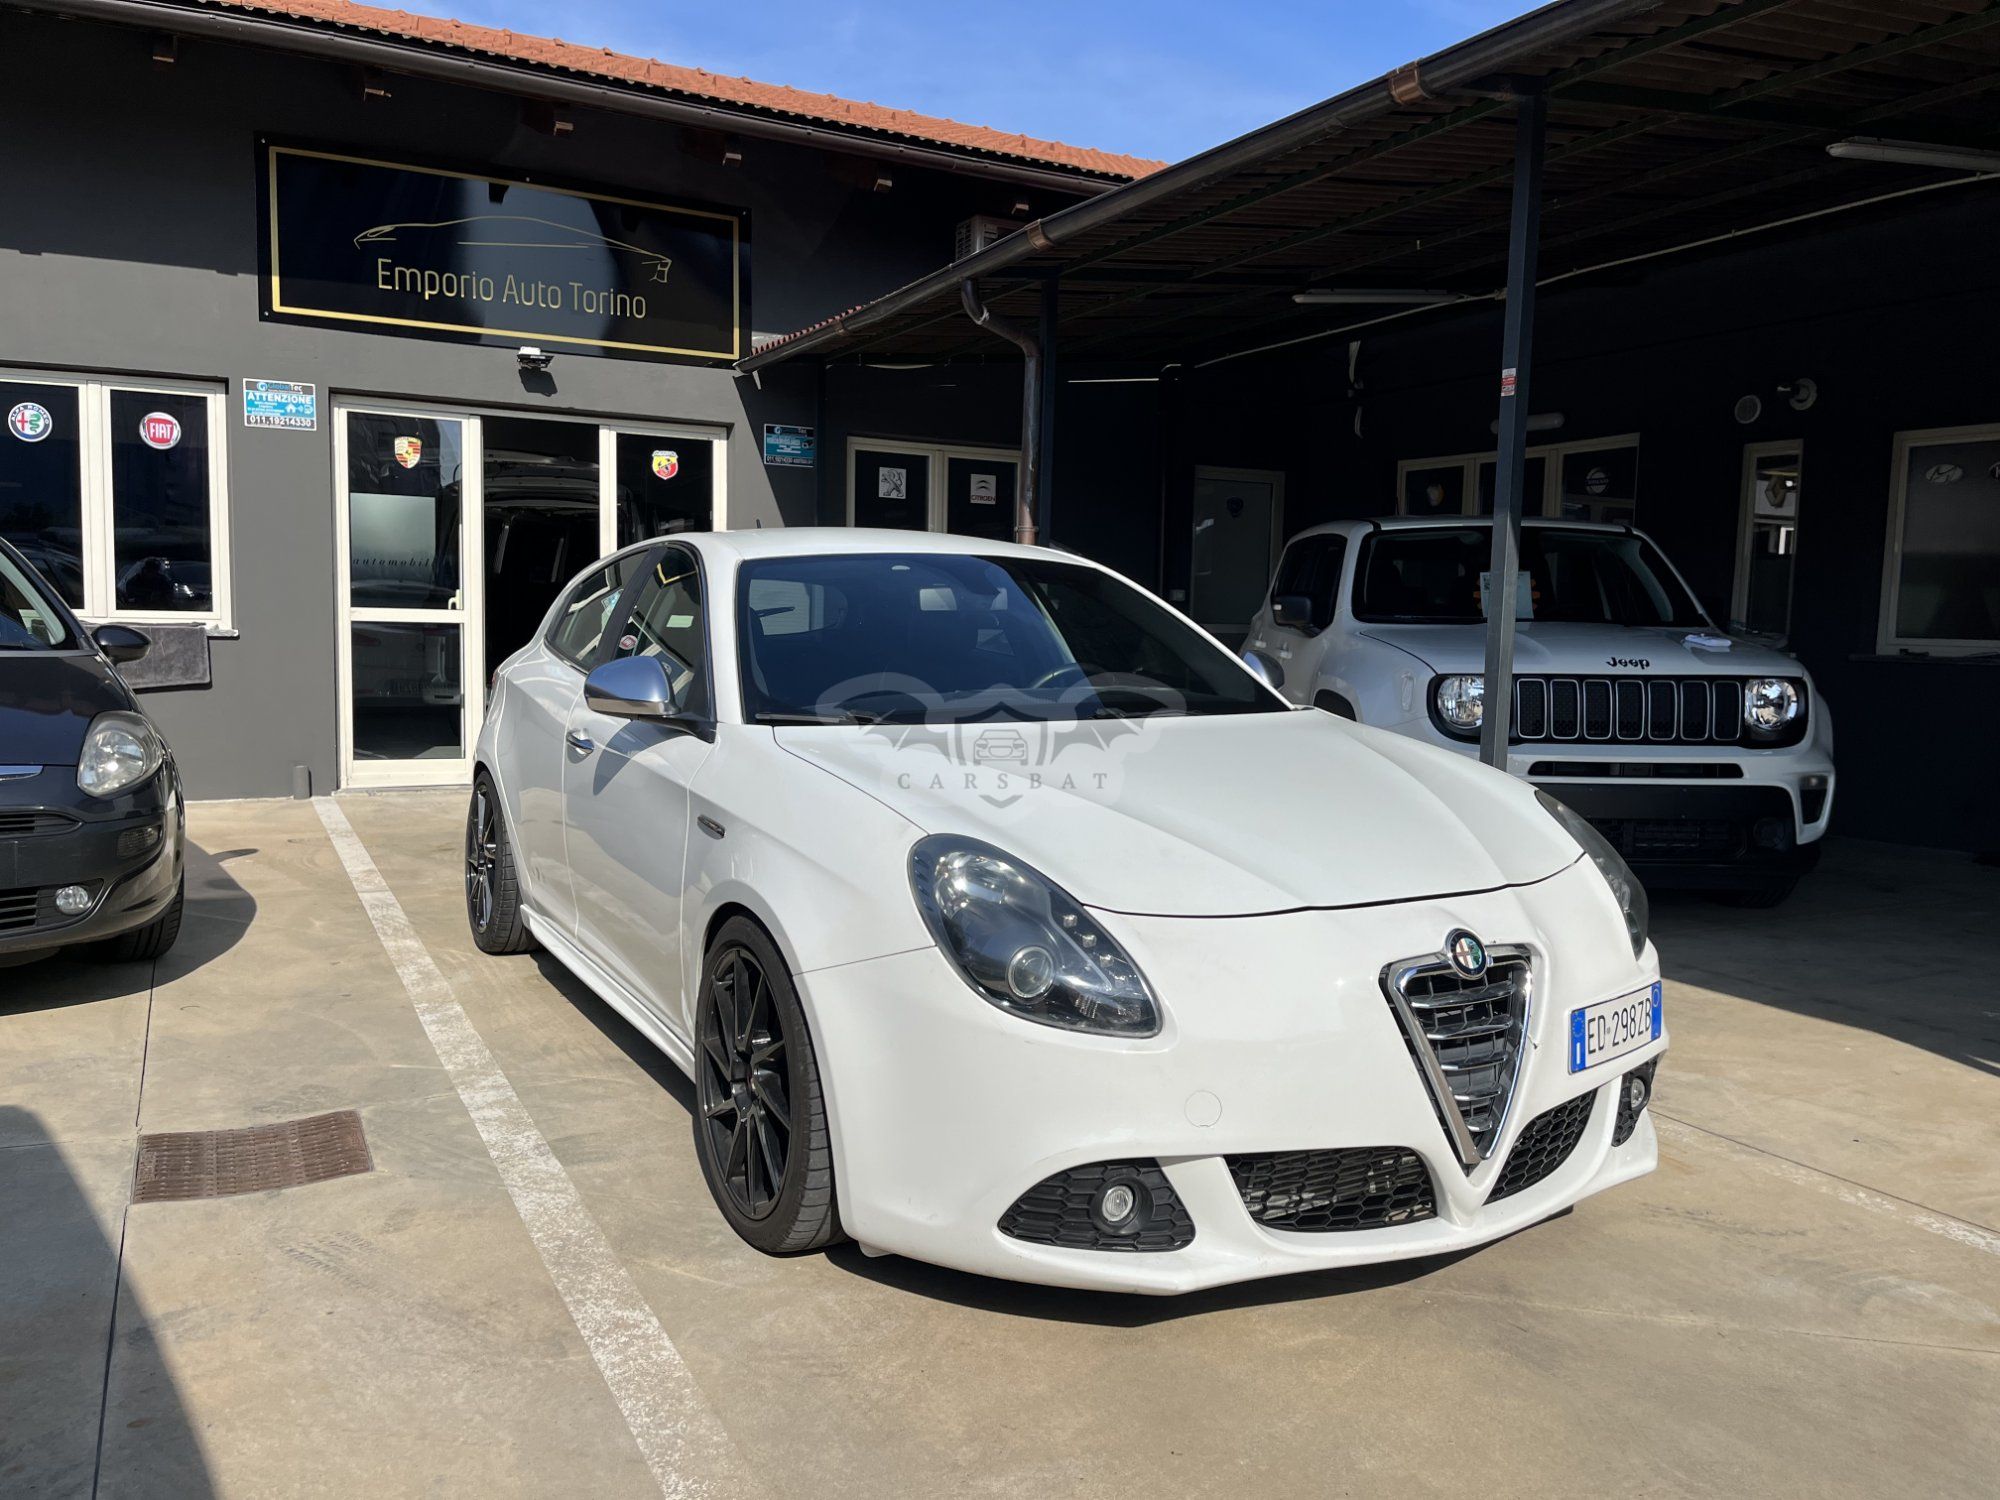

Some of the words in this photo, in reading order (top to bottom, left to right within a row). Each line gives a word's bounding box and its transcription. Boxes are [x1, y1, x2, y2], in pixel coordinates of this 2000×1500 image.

[377, 257, 495, 301] Emporio
[502, 274, 562, 309] Auto
[568, 282, 648, 319] Torino
[247, 391, 312, 405] ATTENZIONE
[11, 406, 25, 422] ALFA
[27, 404, 50, 425] ROMEO
[149, 422, 172, 439] FIAT
[1606, 656, 1650, 670] Jeep
[1587, 1014, 1606, 1055] ED
[1612, 997, 1652, 1047] 298ZB
